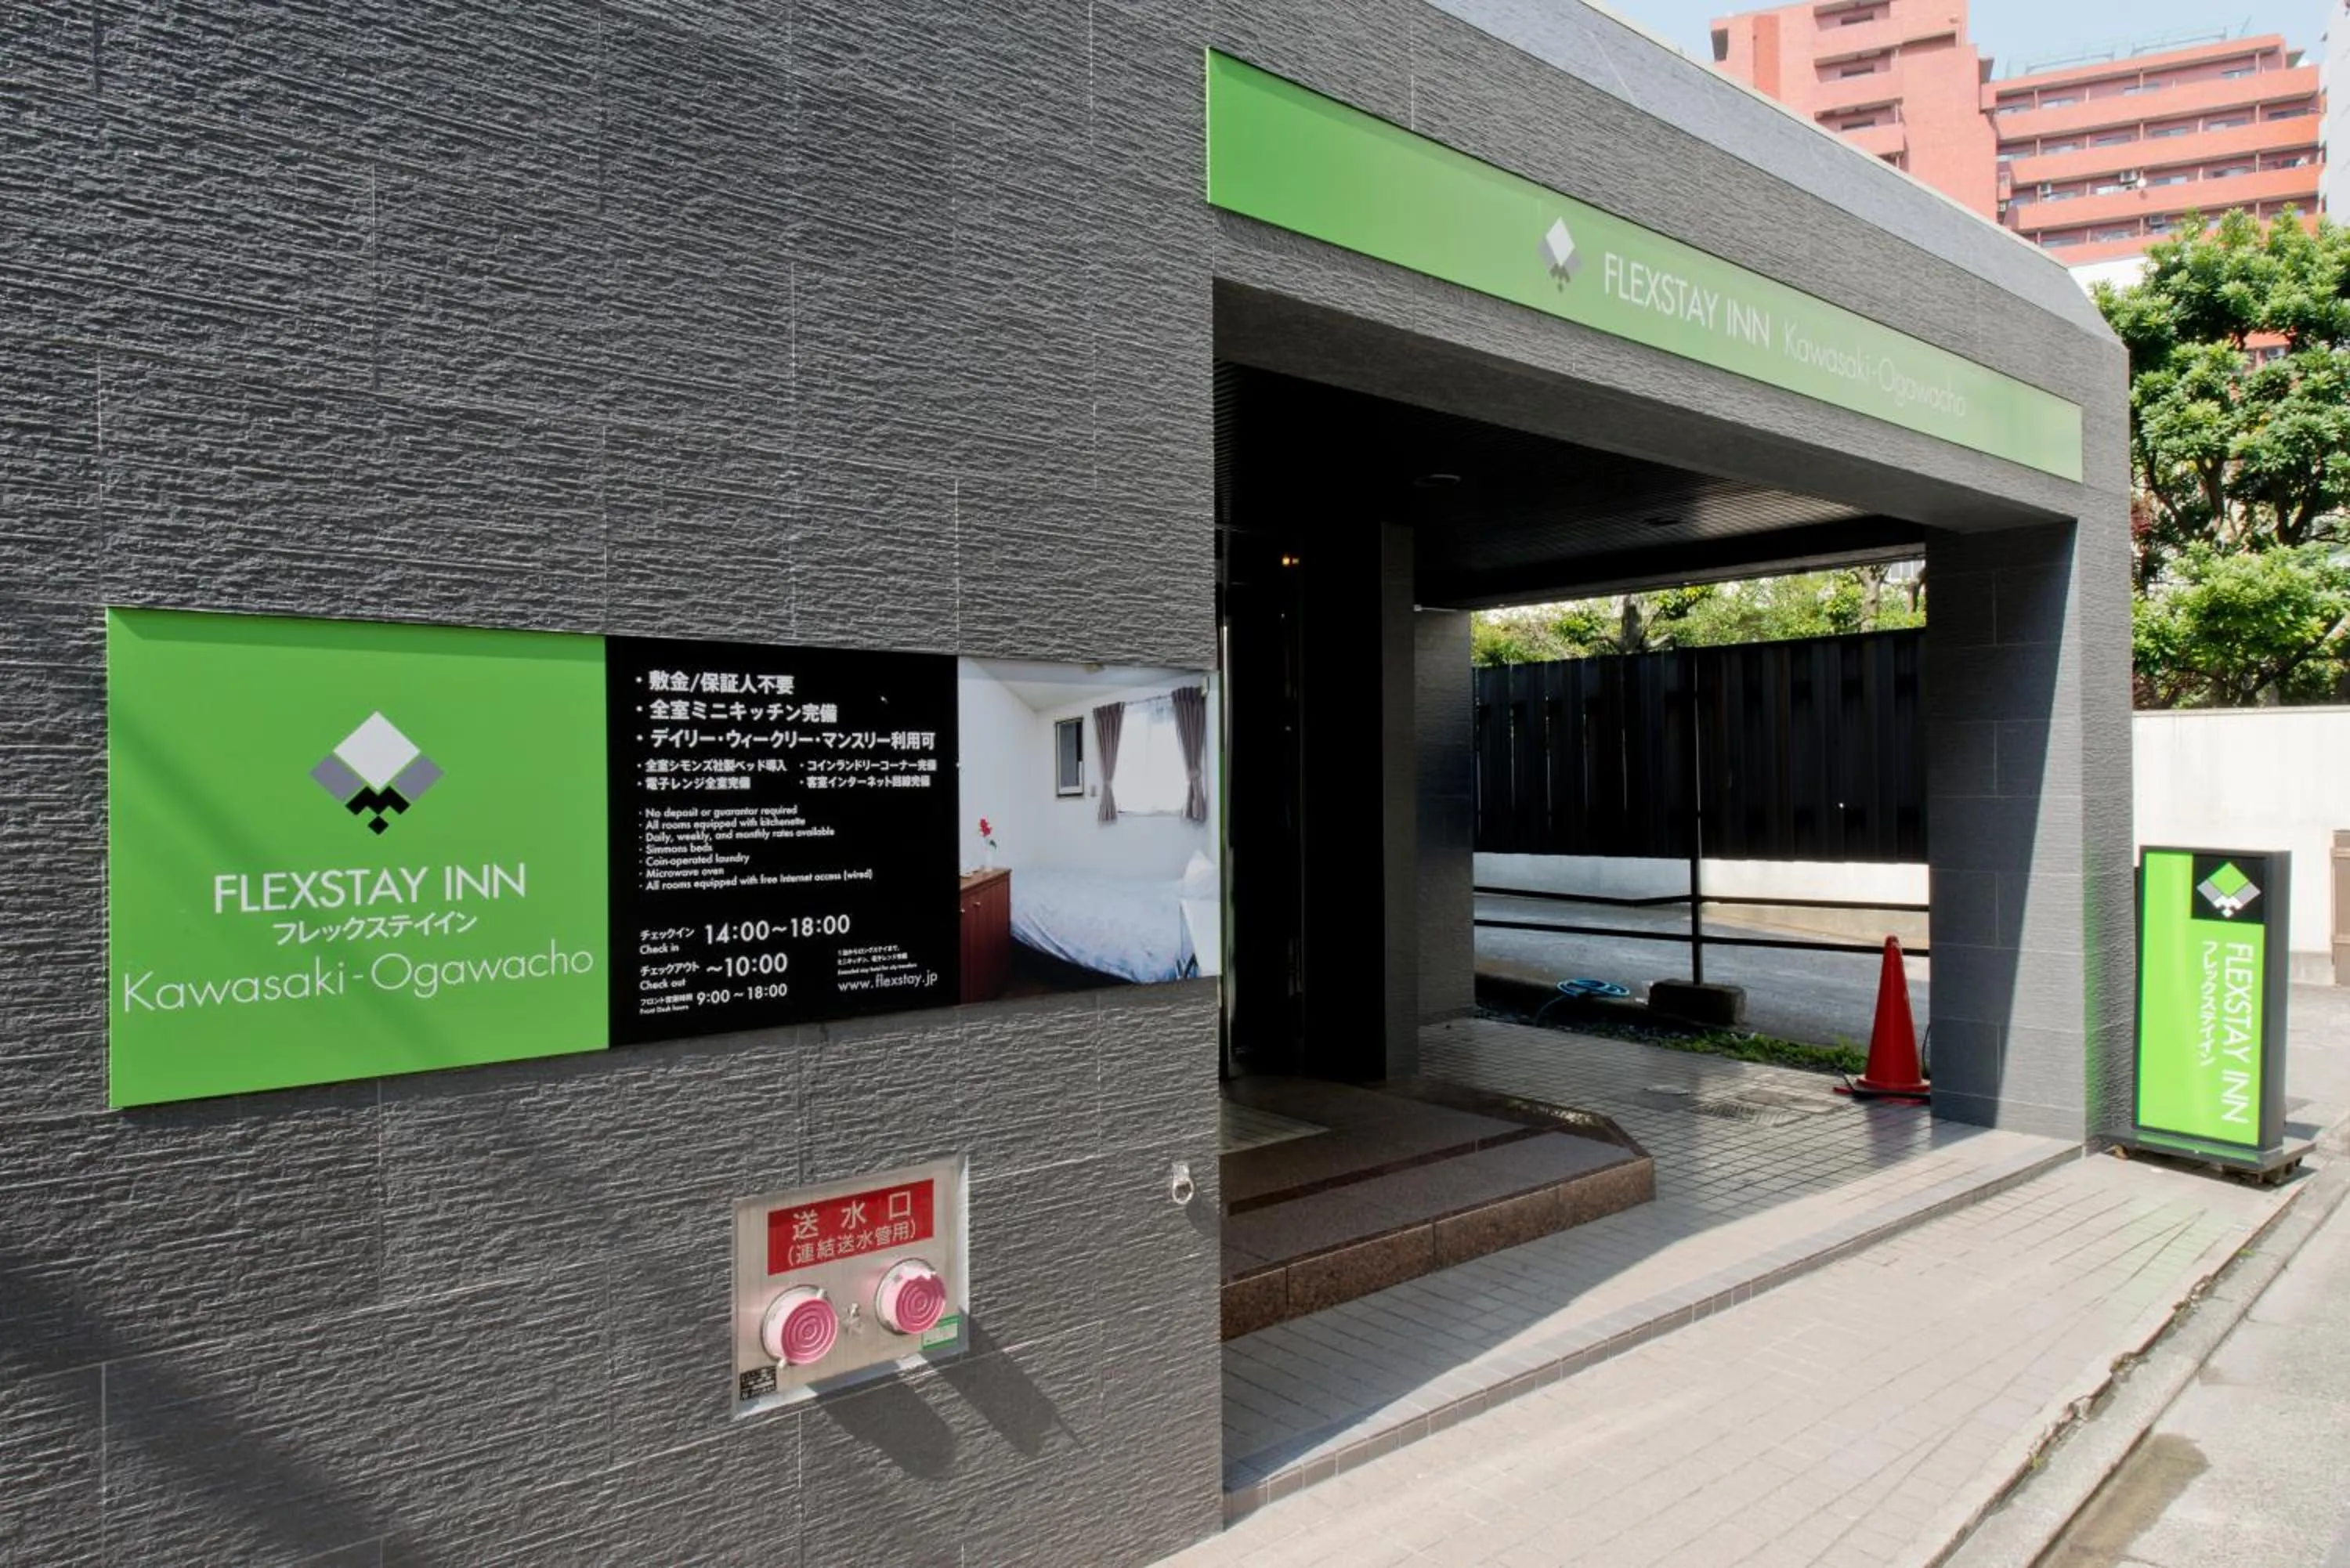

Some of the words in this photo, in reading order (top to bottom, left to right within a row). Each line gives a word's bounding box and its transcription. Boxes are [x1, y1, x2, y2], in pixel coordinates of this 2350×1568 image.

[1604, 252, 1719, 329] FLEXSTAY
[1726, 297, 1771, 349] INN
[645, 807, 661, 818] No
[663, 807, 698, 819] deposit
[714, 807, 758, 818] guarantor
[761, 804, 797, 817] required
[645, 819, 659, 830] All
[693, 817, 737, 830] equipped
[739, 817, 757, 828] with
[714, 829, 733, 840] and
[736, 828, 770, 840] monthly
[795, 826, 835, 837] available
[645, 844, 688, 854] Simmons
[690, 843, 713, 853] beds
[715, 852, 750, 865] laundry
[645, 868, 699, 878] Microwave
[213, 866, 429, 914] FLEXSTAY
[445, 862, 526, 901] INN
[645, 880, 660, 890] All
[662, 881, 692, 890] rooms
[693, 875, 737, 890] equipped
[739, 874, 758, 885] with
[760, 873, 778, 884] free
[273, 911, 478, 946] フレックステイイン
[640, 927, 695, 940] チェックイン
[639, 943, 667, 955] Check
[671, 942, 679, 952] in
[640, 961, 700, 977] チェックアウト
[639, 979, 668, 991] Check
[671, 978, 686, 988] out
[837, 969, 938, 992] www.flexstay.jp
[2223, 942, 2254, 1064] FLEXSTAY
[2221, 1069, 2251, 1124] INN
[792, 1191, 912, 1241] 送水口
[788, 1220, 916, 1266] (連結送水管用)
